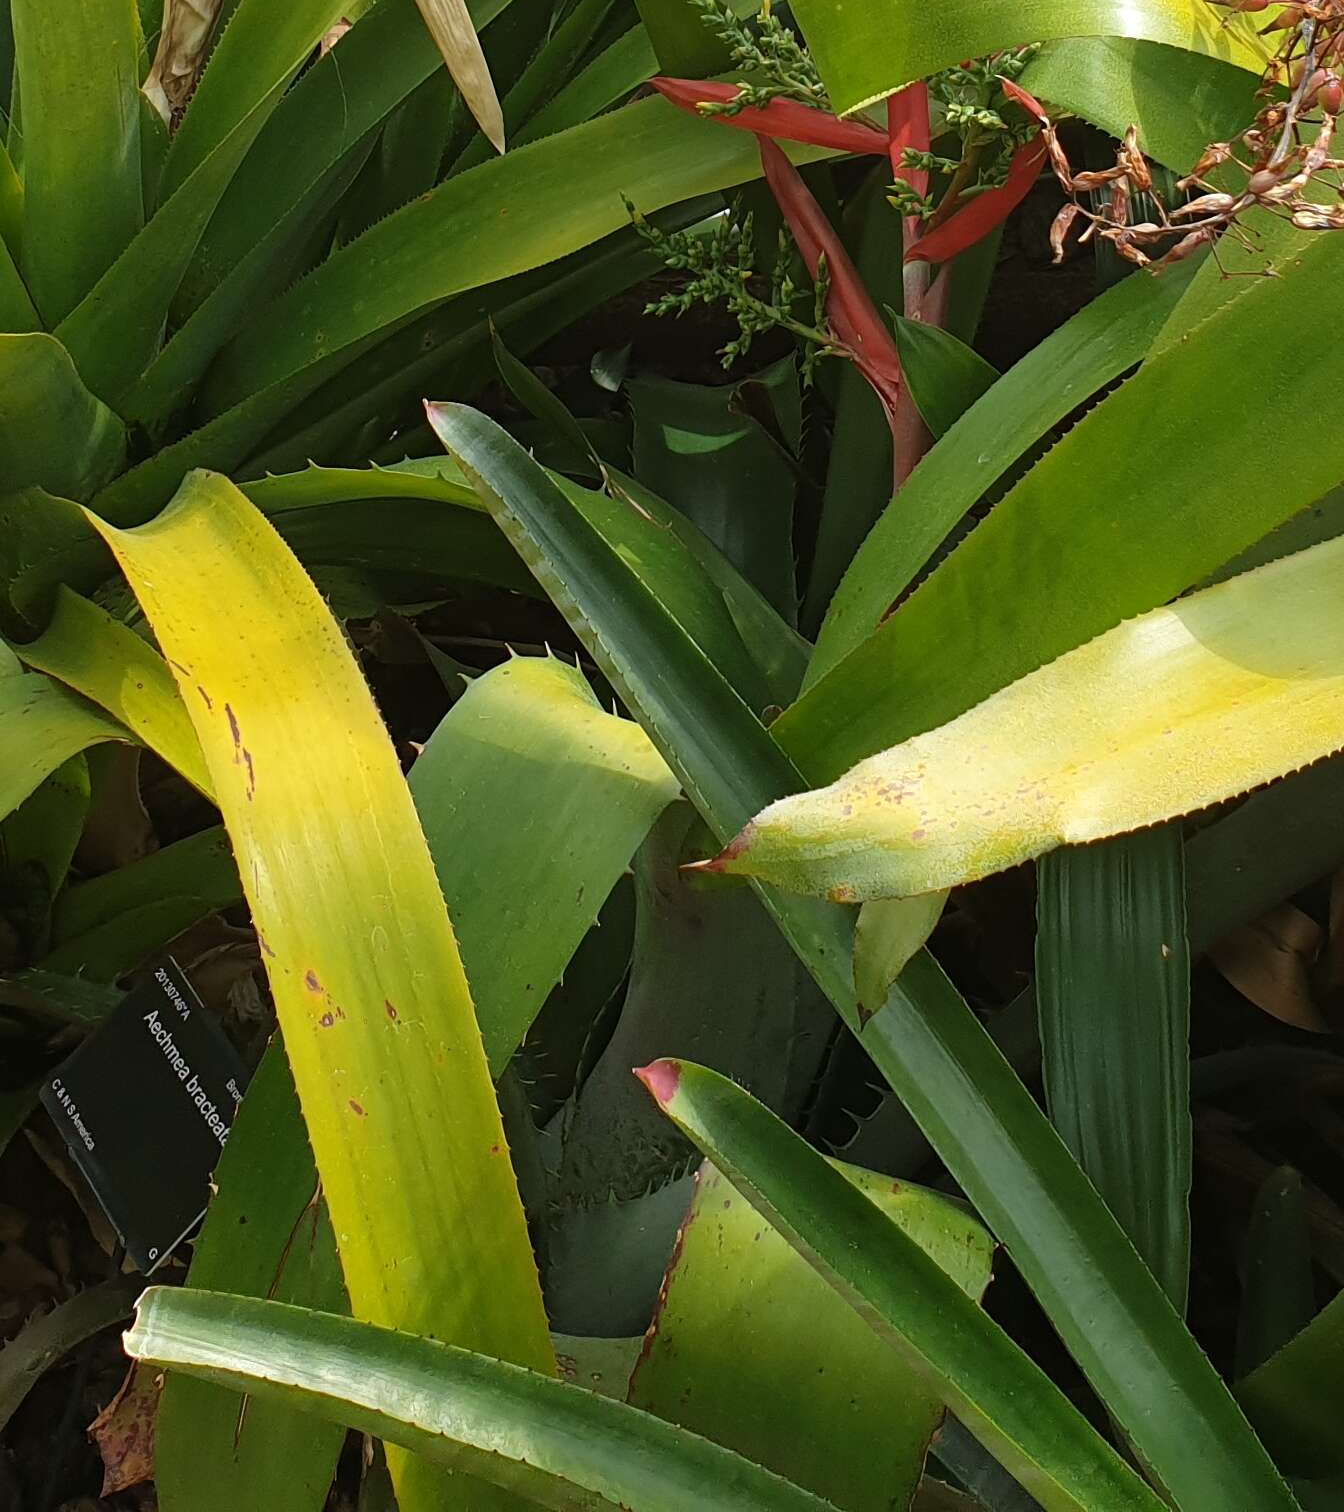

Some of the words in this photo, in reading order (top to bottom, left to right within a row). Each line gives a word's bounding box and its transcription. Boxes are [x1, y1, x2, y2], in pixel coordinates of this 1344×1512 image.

[143, 1010, 189, 1080] Aechmea
[52, 1078, 61, 1090] C
[56, 1087, 66, 1099] &
[61, 1094, 72, 1108] N
[67, 1104, 76, 1116] S
[70, 1113, 95, 1151] America
[148, 1247, 158, 1260] G
